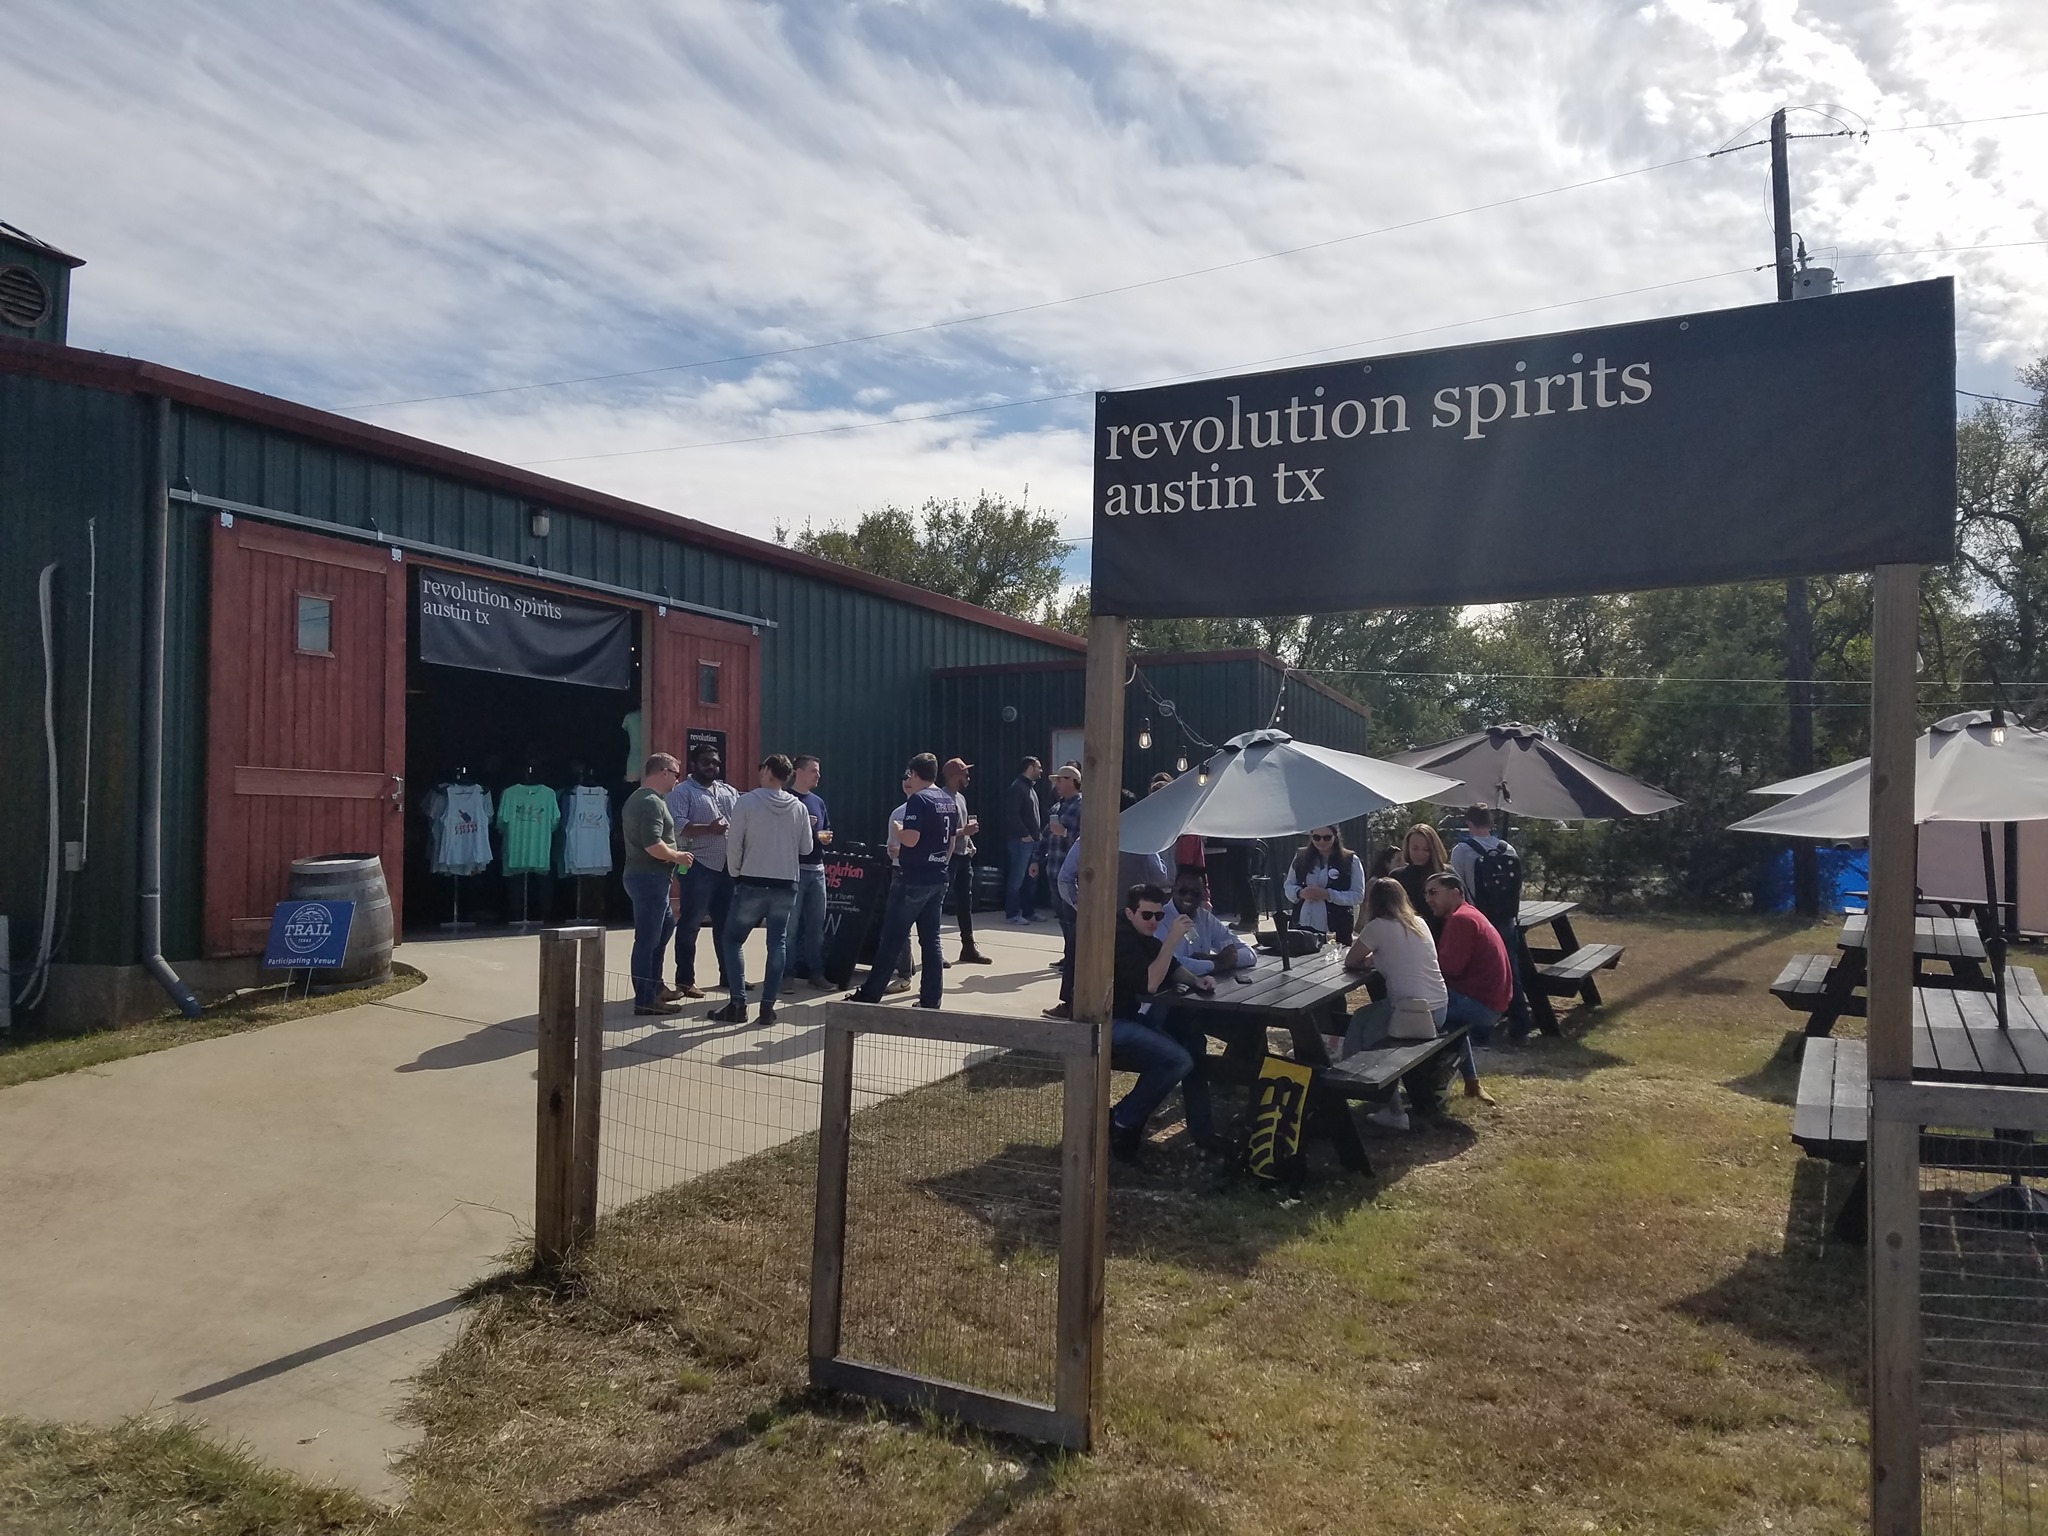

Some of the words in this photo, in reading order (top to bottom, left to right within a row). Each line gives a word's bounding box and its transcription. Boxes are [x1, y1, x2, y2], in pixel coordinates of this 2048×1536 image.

[1105, 385, 1411, 460] revolution
[1431, 352, 1653, 440] spirits
[1104, 462, 1257, 516] austin
[1272, 462, 1326, 504] tx
[423, 579, 510, 609] revolution
[514, 597, 562, 620] spirits
[422, 600, 472, 624] austin
[474, 611, 491, 625] tx
[689, 733, 718, 743] revolution
[943, 816, 950, 844] 3
[824, 861, 864, 880] volution
[285, 924, 331, 936] TRAIL
[268, 957, 311, 965] Participating
